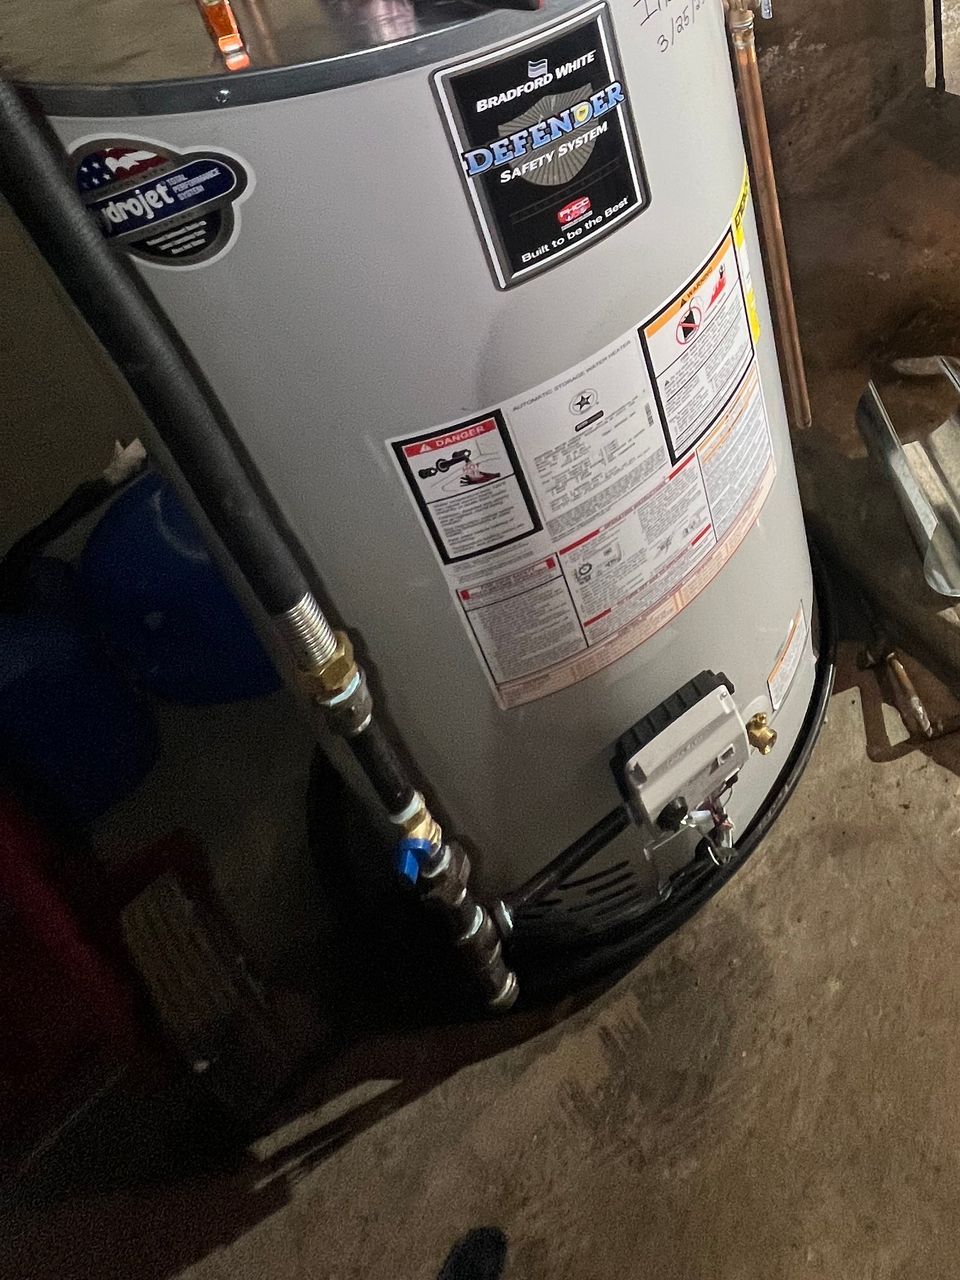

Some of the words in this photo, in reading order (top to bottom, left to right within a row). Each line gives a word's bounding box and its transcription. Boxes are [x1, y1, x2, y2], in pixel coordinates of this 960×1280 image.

[476, 72, 554, 113] BRADFORD
[555, 50, 597, 80] WHITE
[461, 81, 625, 177] DEFENDER
[500, 151, 554, 184] SAFETY
[558, 121, 608, 158] SYSTEM
[172, 167, 221, 193] PERFORMANCE
[177, 184, 204, 201] SYSTEM
[521, 244, 550, 263] Built
[551, 237, 565, 248] to
[566, 227, 583, 241] be
[584, 215, 603, 230] the
[604, 197, 629, 218] Best
[559, 196, 591, 218] PHCC
[685, 266, 713, 299] WARNING
[512, 390, 553, 412] AUTOMATIC
[554, 371, 586, 393] STORAGE
[586, 357, 608, 373] WATER
[607, 339, 631, 358] HEATER
[435, 425, 486, 448] DANGER
